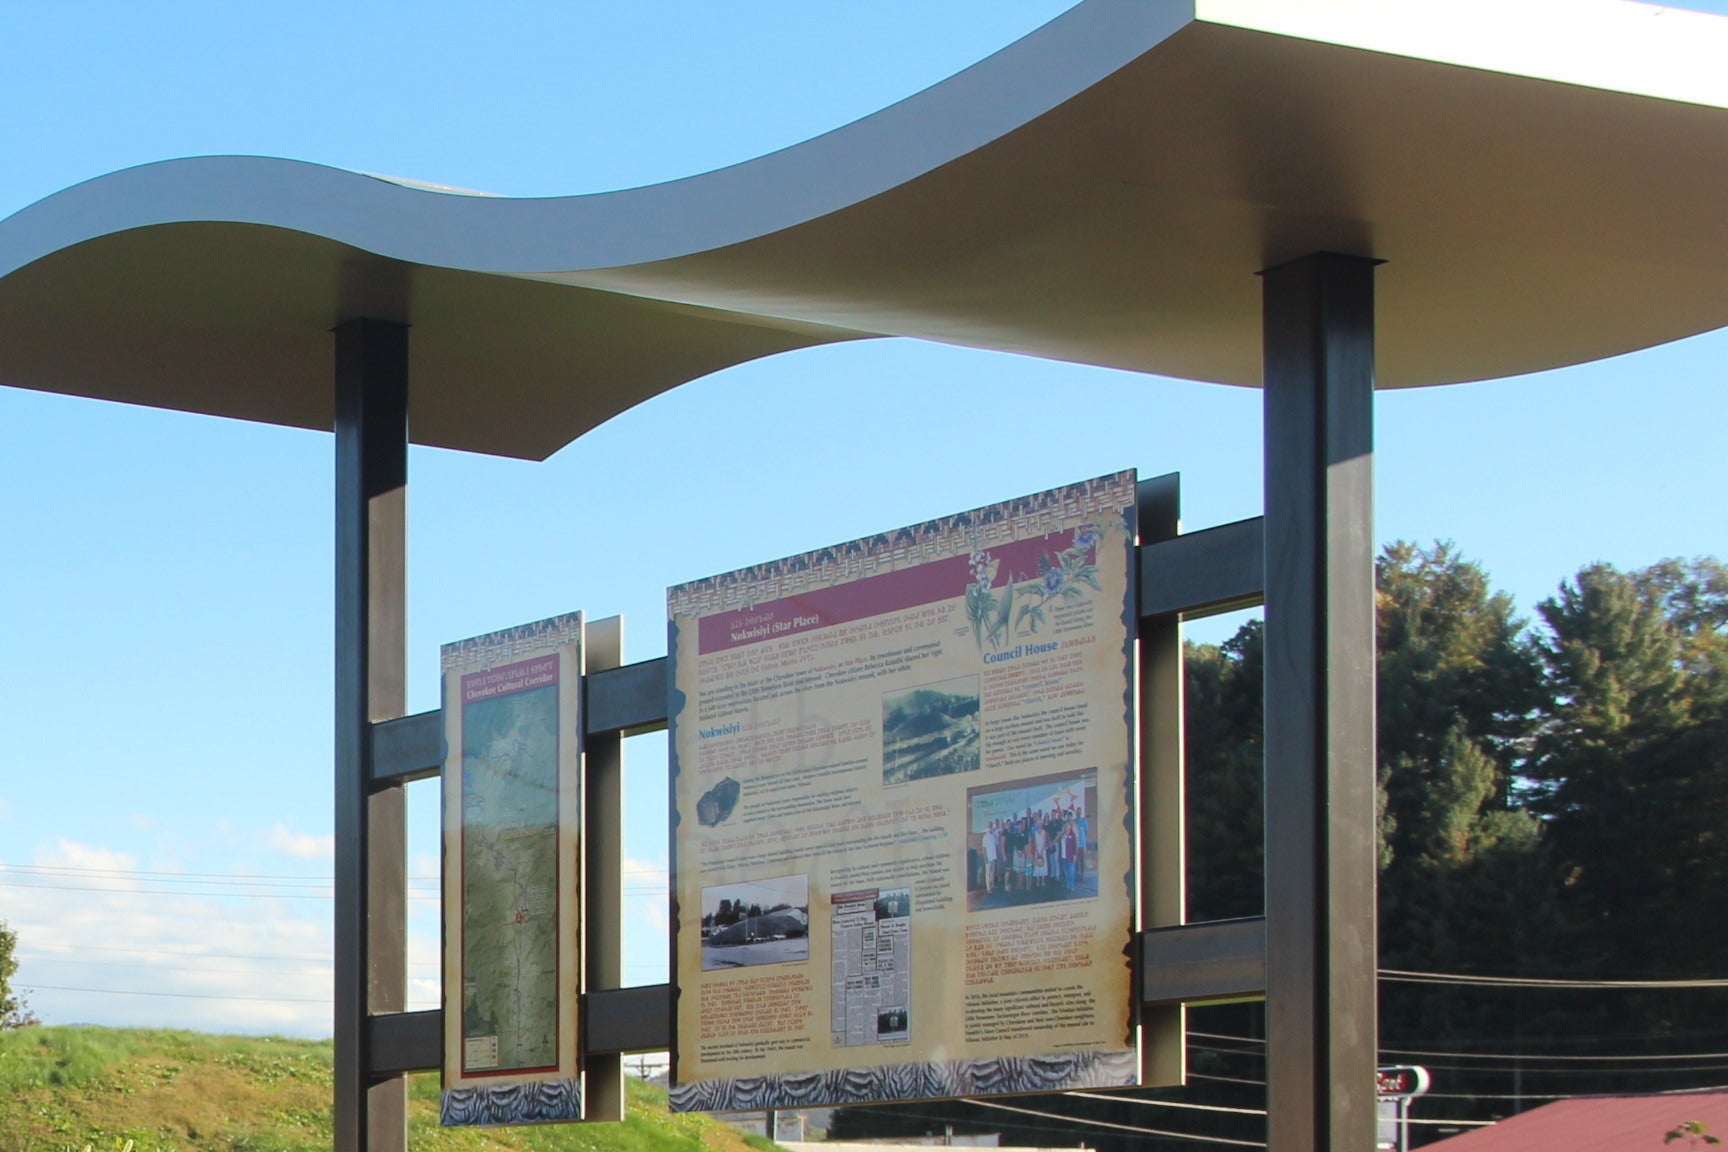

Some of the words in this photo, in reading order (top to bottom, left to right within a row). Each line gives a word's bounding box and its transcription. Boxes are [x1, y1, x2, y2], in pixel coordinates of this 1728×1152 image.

[731, 623, 770, 642] Nokwisiyi
[772, 619, 791, 634] (Star
[793, 614, 819, 628] Place)
[983, 646, 1022, 664] Council
[1025, 641, 1058, 656] House
[466, 686, 497, 700] Cherokee
[497, 680, 524, 693] Cultural
[524, 673, 553, 686] Corridor
